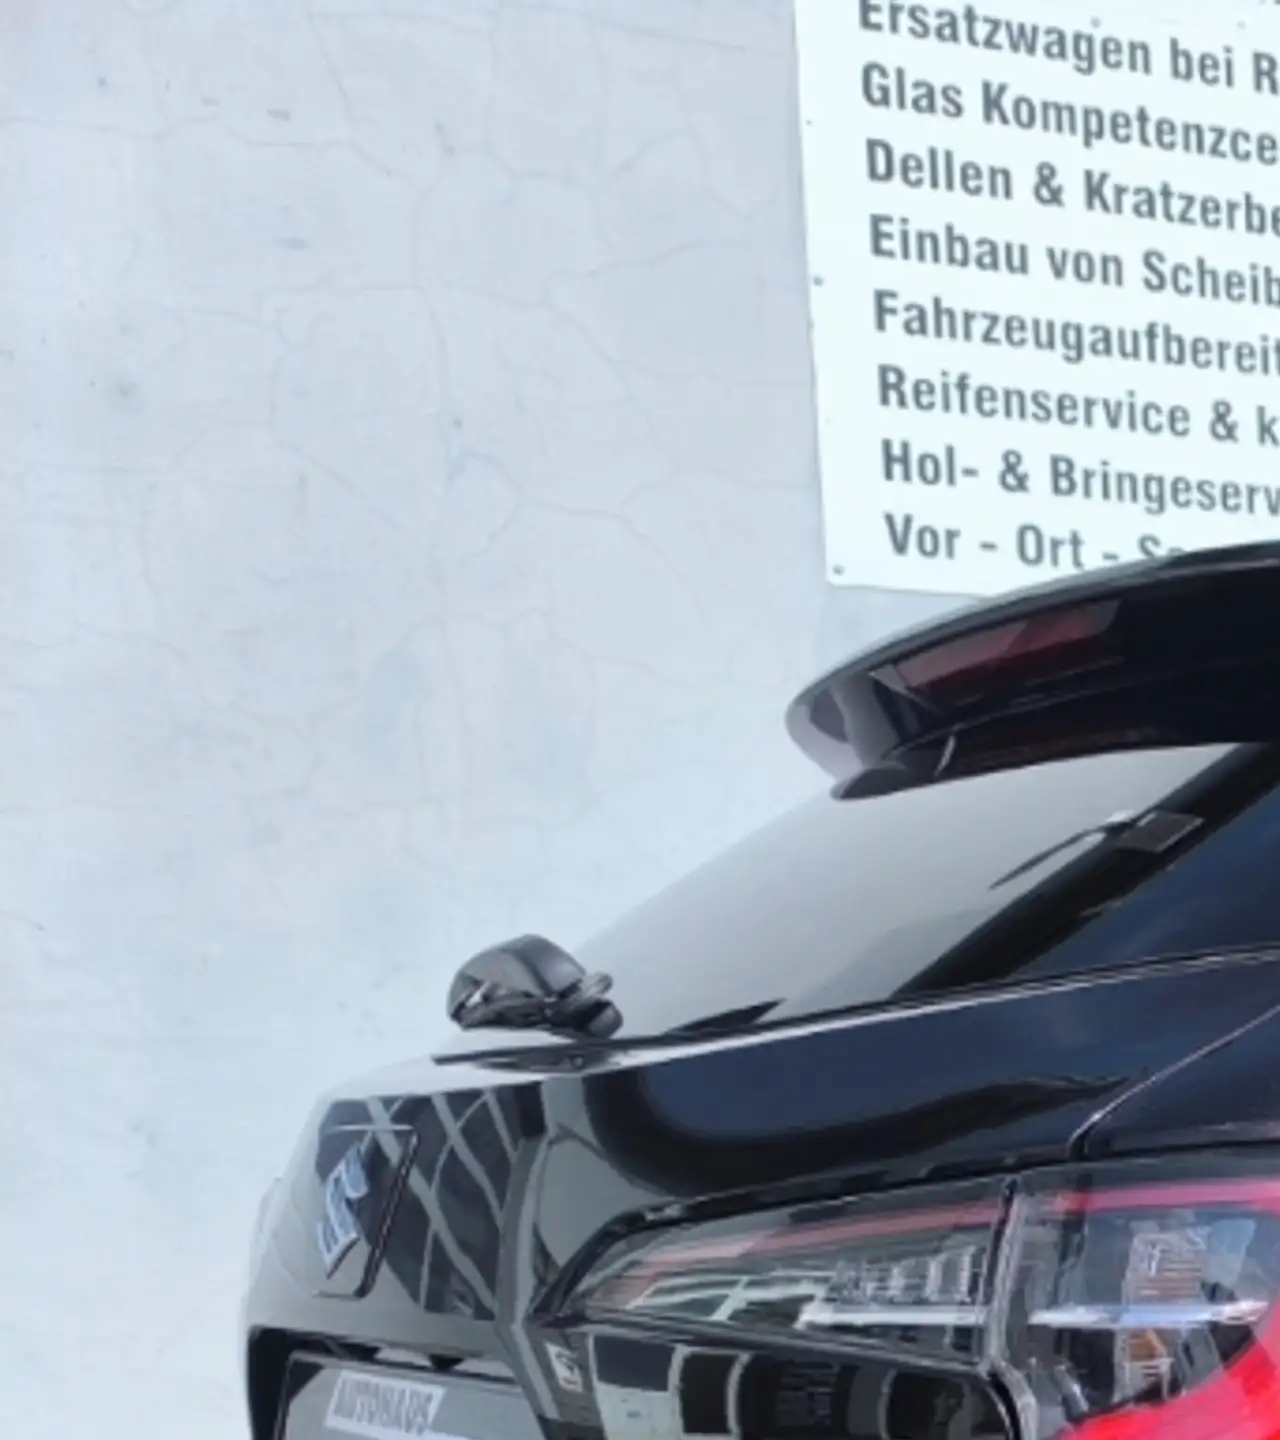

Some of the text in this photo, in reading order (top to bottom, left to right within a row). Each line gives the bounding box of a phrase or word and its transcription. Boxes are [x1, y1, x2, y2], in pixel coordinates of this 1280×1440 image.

[858, 0, 1151, 76] Ersatzwagen
[1170, 38, 1234, 88] bei
[862, 62, 963, 118] Glas
[866, 138, 1012, 200] Dellen
[1033, 162, 1064, 207] &
[870, 214, 1029, 275] Einbau
[1046, 247, 1124, 287] von
[878, 364, 1191, 438] Reifenservice
[1209, 400, 1238, 443] &
[882, 438, 979, 486] Hol-
[999, 450, 1030, 493] &
[884, 512, 961, 560] Vor
[1016, 524, 1085, 569] Ort
